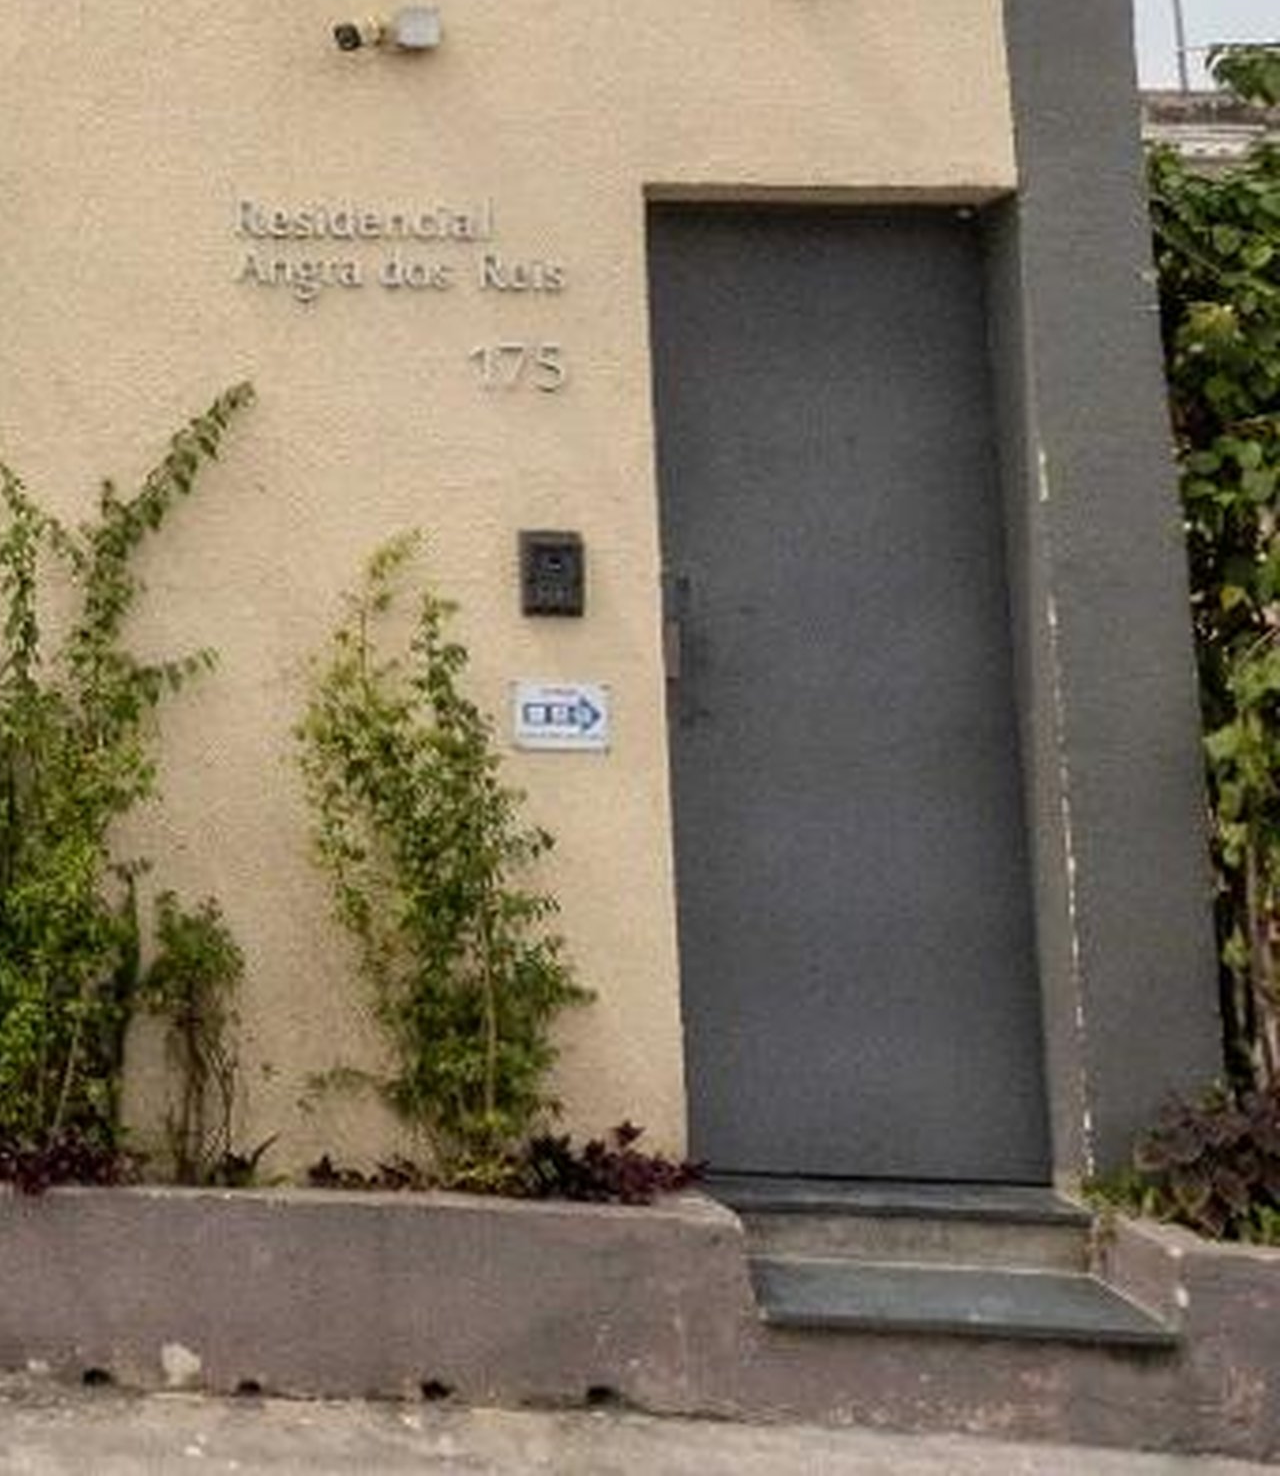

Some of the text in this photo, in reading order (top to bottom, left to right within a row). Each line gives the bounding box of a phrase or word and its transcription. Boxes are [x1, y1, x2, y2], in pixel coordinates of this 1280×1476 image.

[237, 197, 495, 242] Residencial
[238, 251, 363, 303] Angra
[378, 249, 454, 290] dos
[468, 343, 566, 393] 175
